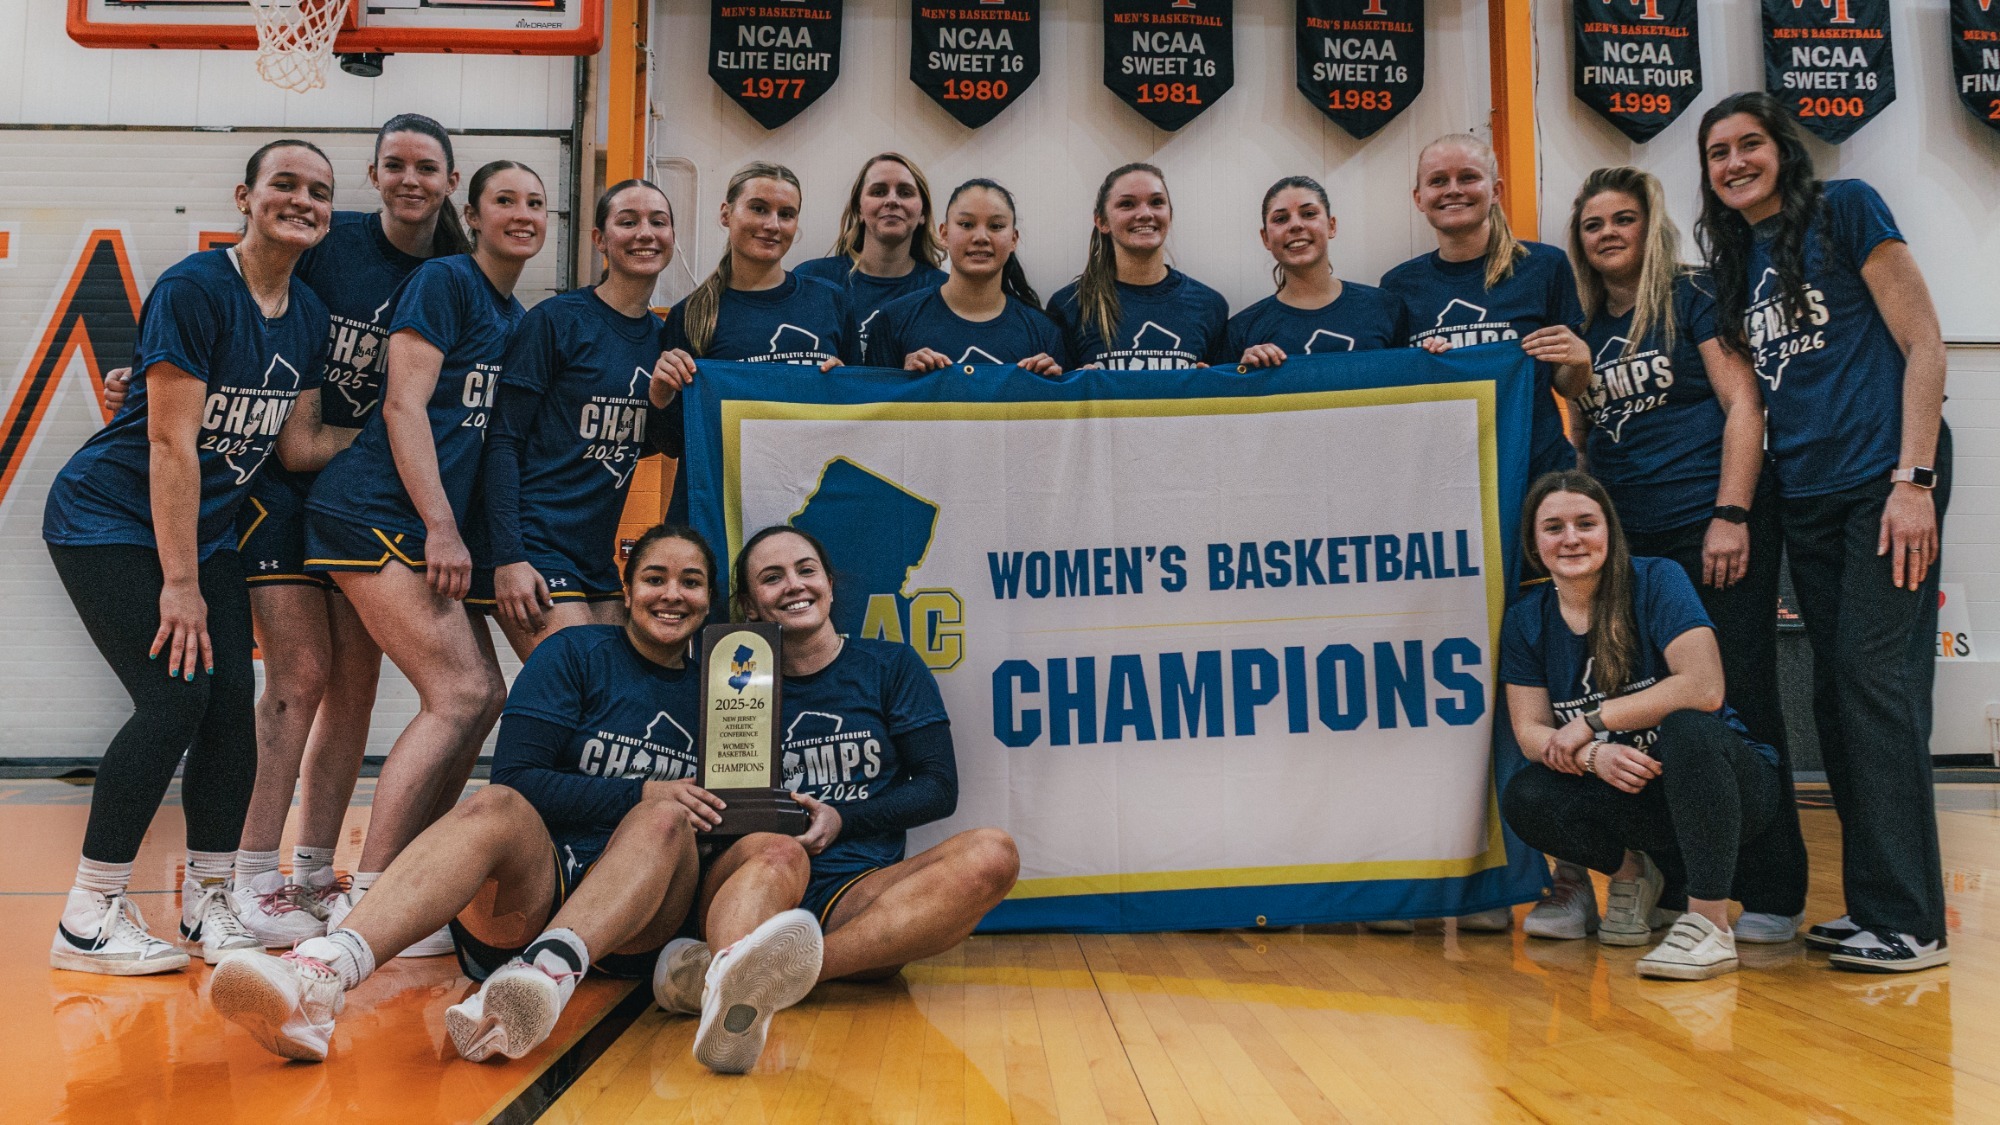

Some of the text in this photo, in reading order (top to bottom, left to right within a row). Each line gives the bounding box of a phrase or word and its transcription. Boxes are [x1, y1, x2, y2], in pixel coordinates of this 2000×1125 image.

[721, 7, 832, 20] MEN'S BASKETBALL
[921, 8, 1030, 22] MEN'S BASKETBALL
[1114, 13, 1223, 27] MEN'S BASKETBALL
[1306, 17, 1414, 33] MEN'S BASKETBALL
[1584, 22, 1690, 38] MEN'S BASKETBALL
[1773, 28, 1884, 40] MEN'S BASKETBALL
[738, 25, 813, 48] NCAA
[939, 28, 1013, 51] NCAA
[1132, 30, 1205, 54] NCAA
[1324, 38, 1397, 61] NCAA
[1603, 40, 1674, 66] NCAA
[1792, 46, 1868, 68] NCAA
[718, 50, 832, 72] ELITE EIGHT
[928, 52, 1024, 72] SWEET 16
[1122, 56, 1216, 76] SWEET 16
[1312, 62, 1408, 84] SWEET 16
[1583, 66, 1694, 87] FINAL FOUR
[1782, 71, 1878, 90] SWEET 16
[741, 77, 806, 98] 1977
[943, 79, 1008, 100] 1980
[1962, 74, 2000, 93] FIN
[1136, 83, 1202, 106] 1981
[1328, 89, 1392, 111] 1983
[1608, 92, 1671, 114] 1999
[1798, 97, 1865, 118] 2000
[345, 319, 370, 330] JERSEY
[1437, 325, 1468, 334] ATHLETIC
[1470, 322, 1510, 331] CONFERENCE
[773, 352, 804, 360] ATHLETIC
[220, 386, 237, 394] NEW
[988, 529, 1480, 600] WOMEN'S BASKETBALL
[861, 587, 966, 673] AC
[992, 637, 1486, 748] CHAMPIONS
[715, 698, 764, 711] 2025-26
[598, 730, 614, 740] NEW
[616, 735, 642, 747] JERSEY
[644, 742, 676, 756] ATHLETIC
[722, 742, 754, 750] WOMEN'S
[788, 738, 822, 750] ATHLETIC
[825, 730, 871, 743] CONFERENCE
[718, 750, 758, 758] BASKETBALL
[712, 762, 764, 773] CHAMPIONS
